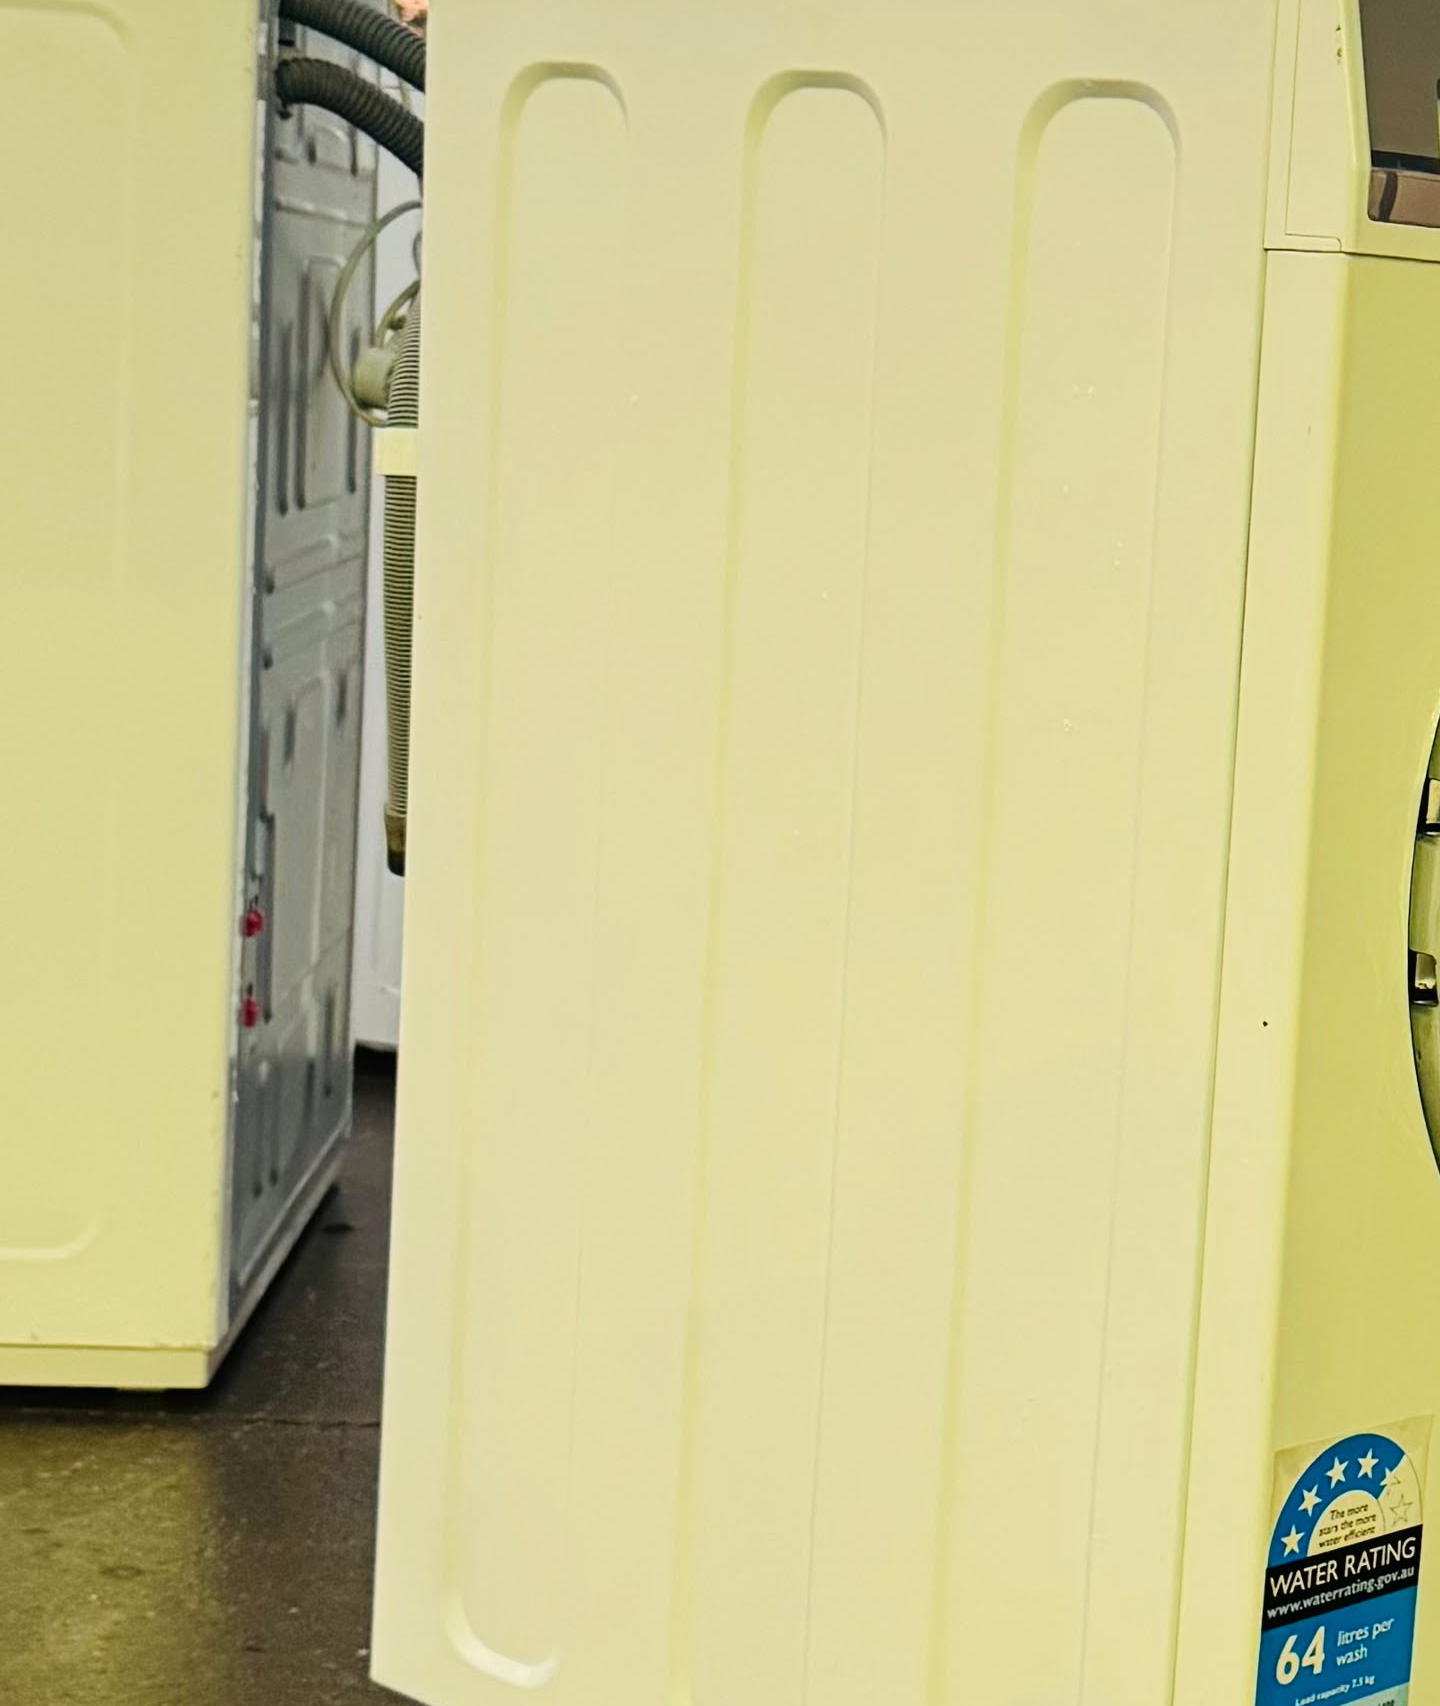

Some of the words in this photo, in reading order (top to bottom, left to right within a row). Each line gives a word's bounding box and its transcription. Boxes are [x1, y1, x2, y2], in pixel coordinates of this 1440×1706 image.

[1330, 1509, 1344, 1520] The
[1347, 1504, 1368, 1517] more
[1340, 1519, 1353, 1531] the
[1355, 1514, 1376, 1526] more
[1344, 1526, 1375, 1542] efficient
[1270, 1560, 1338, 1597] WATER
[1344, 1536, 1416, 1577] RATING
[1267, 1566, 1415, 1619] www.waterrating.gov.au
[1337, 1626, 1369, 1647] litres
[1372, 1617, 1395, 1640] per
[1275, 1625, 1325, 1685] 64
[1336, 1643, 1368, 1666] wash
